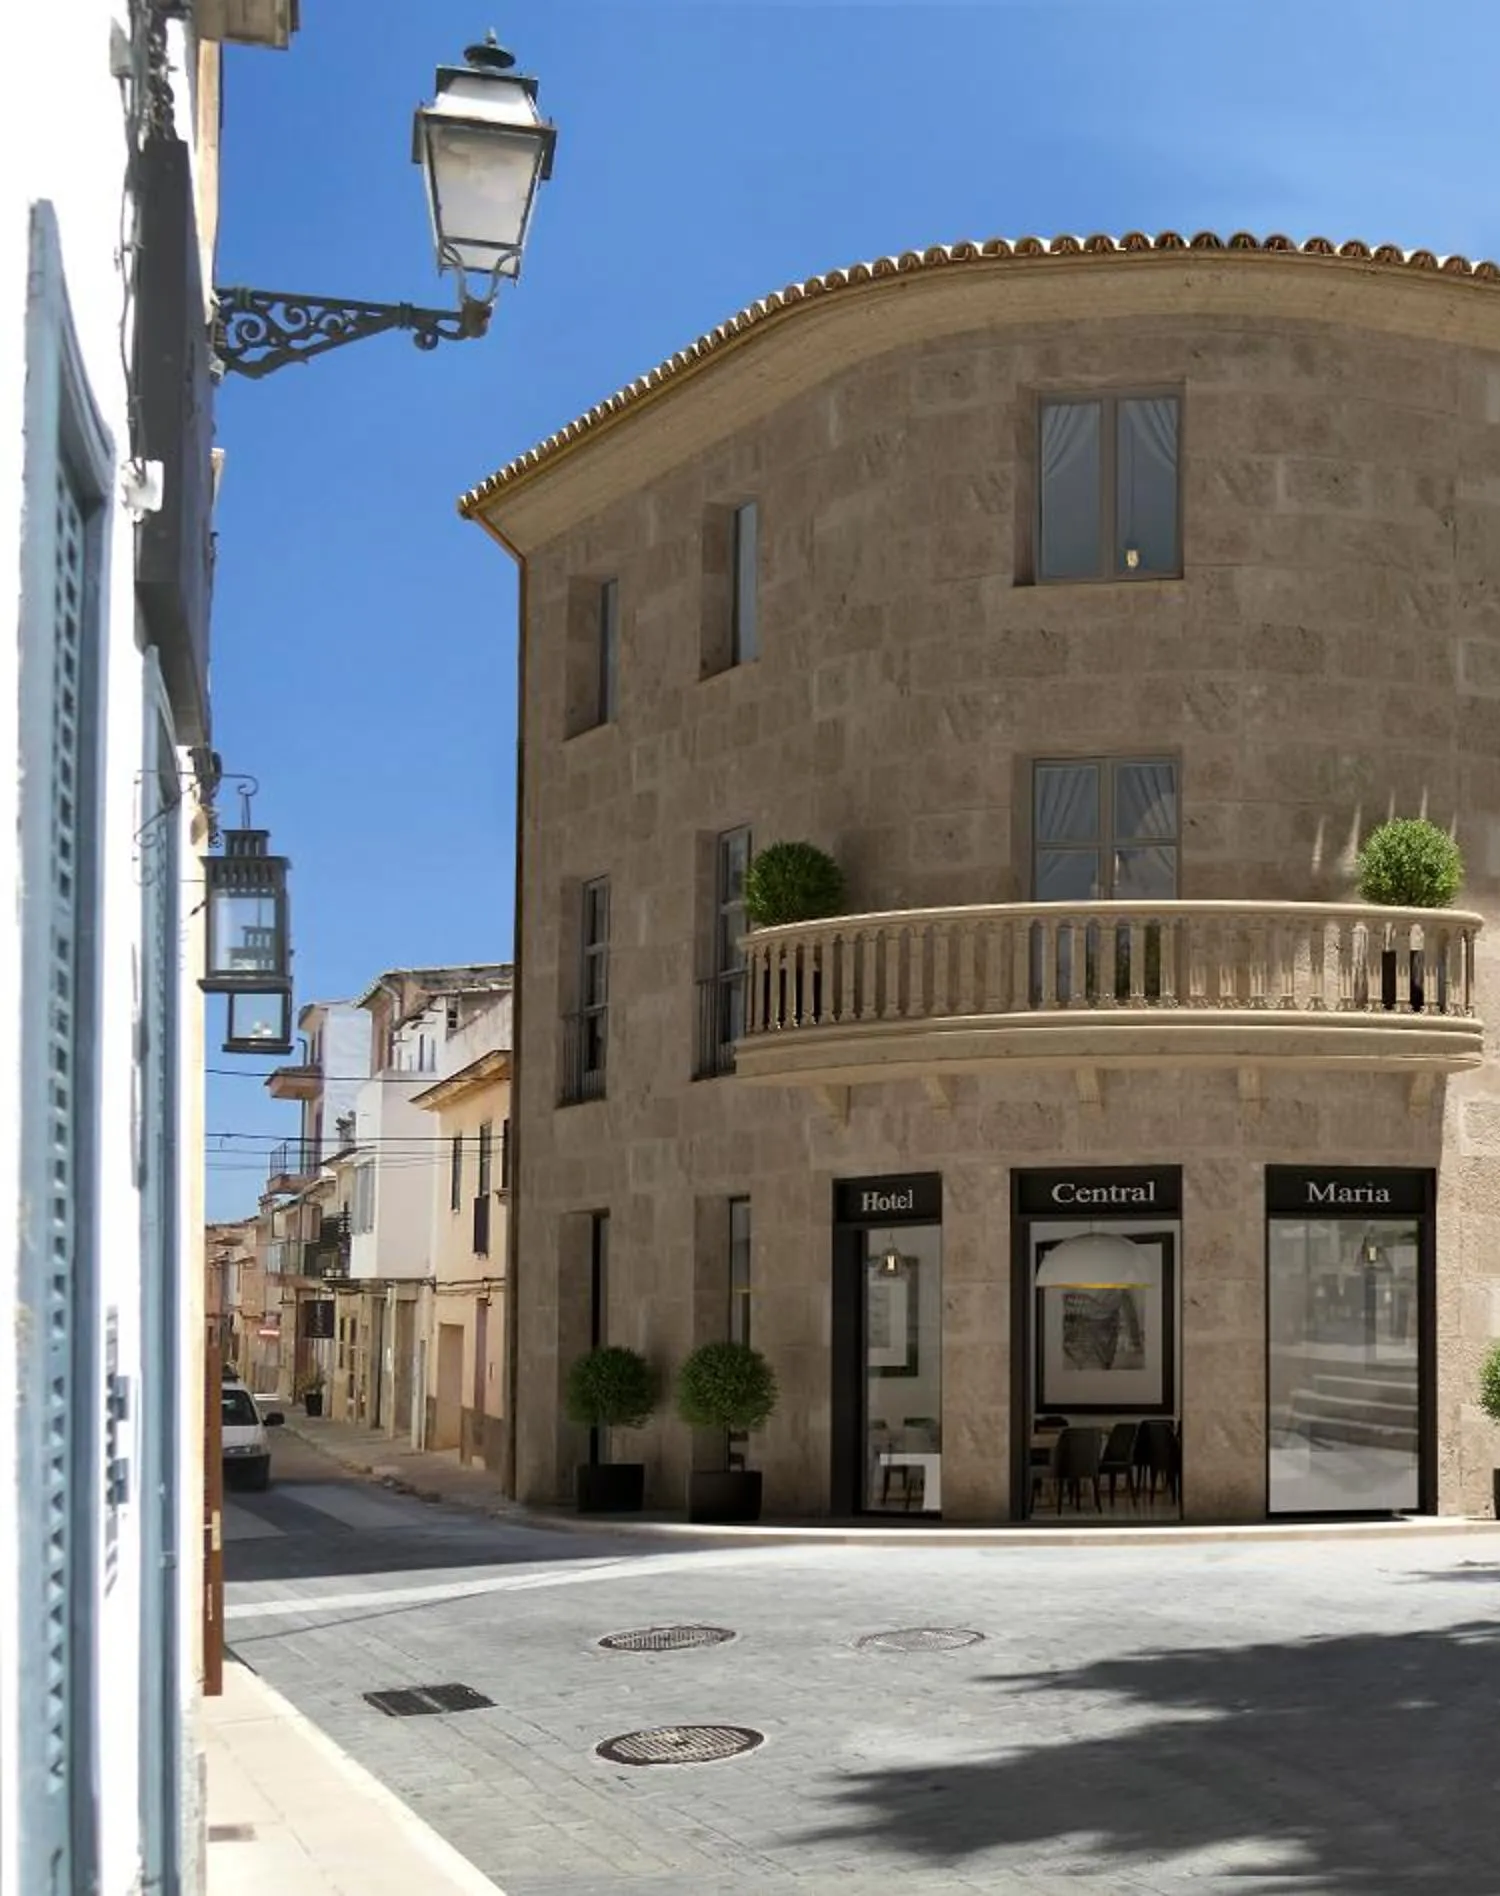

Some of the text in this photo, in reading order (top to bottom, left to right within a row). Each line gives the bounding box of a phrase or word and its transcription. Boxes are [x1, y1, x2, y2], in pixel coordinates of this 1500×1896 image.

[861, 1180, 1391, 1211] Hotel Central Maria
